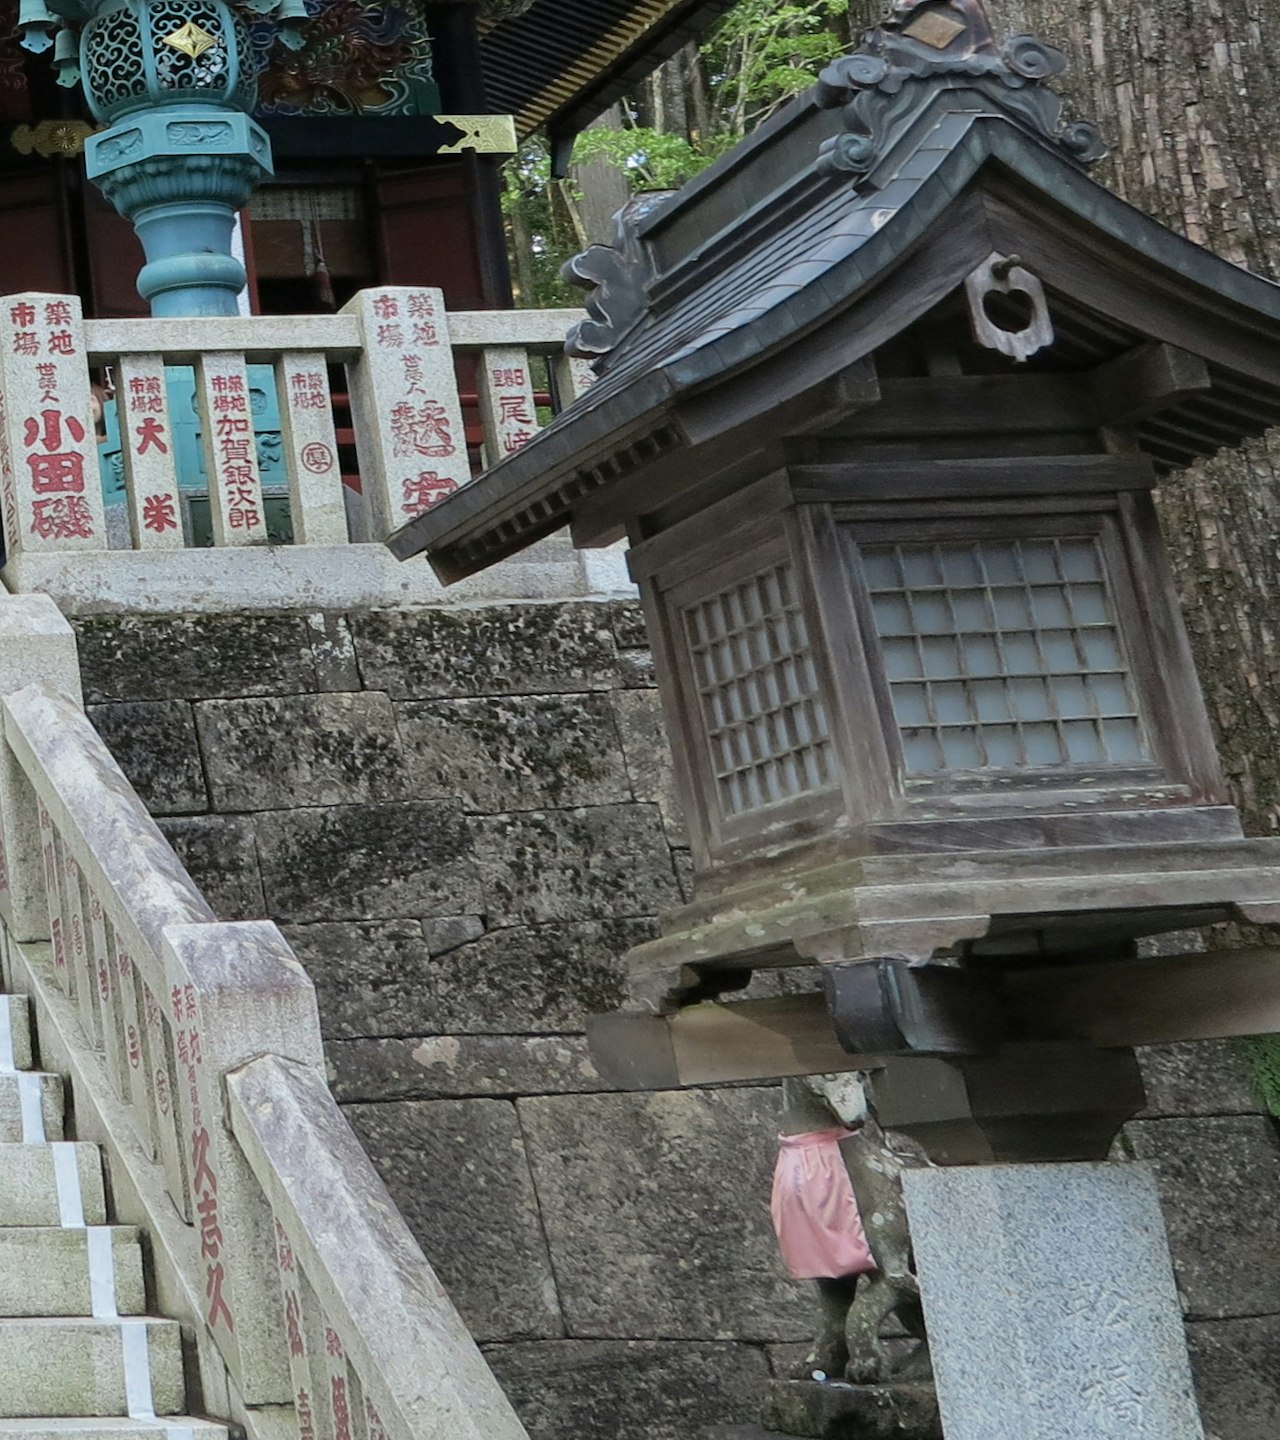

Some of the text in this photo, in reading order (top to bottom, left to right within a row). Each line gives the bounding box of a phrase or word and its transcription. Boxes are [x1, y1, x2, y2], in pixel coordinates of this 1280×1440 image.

[36, 362, 60, 403] 世話人
[23, 409, 95, 540] 小田磯
[217, 414, 261, 530] 加賀銀次郎
